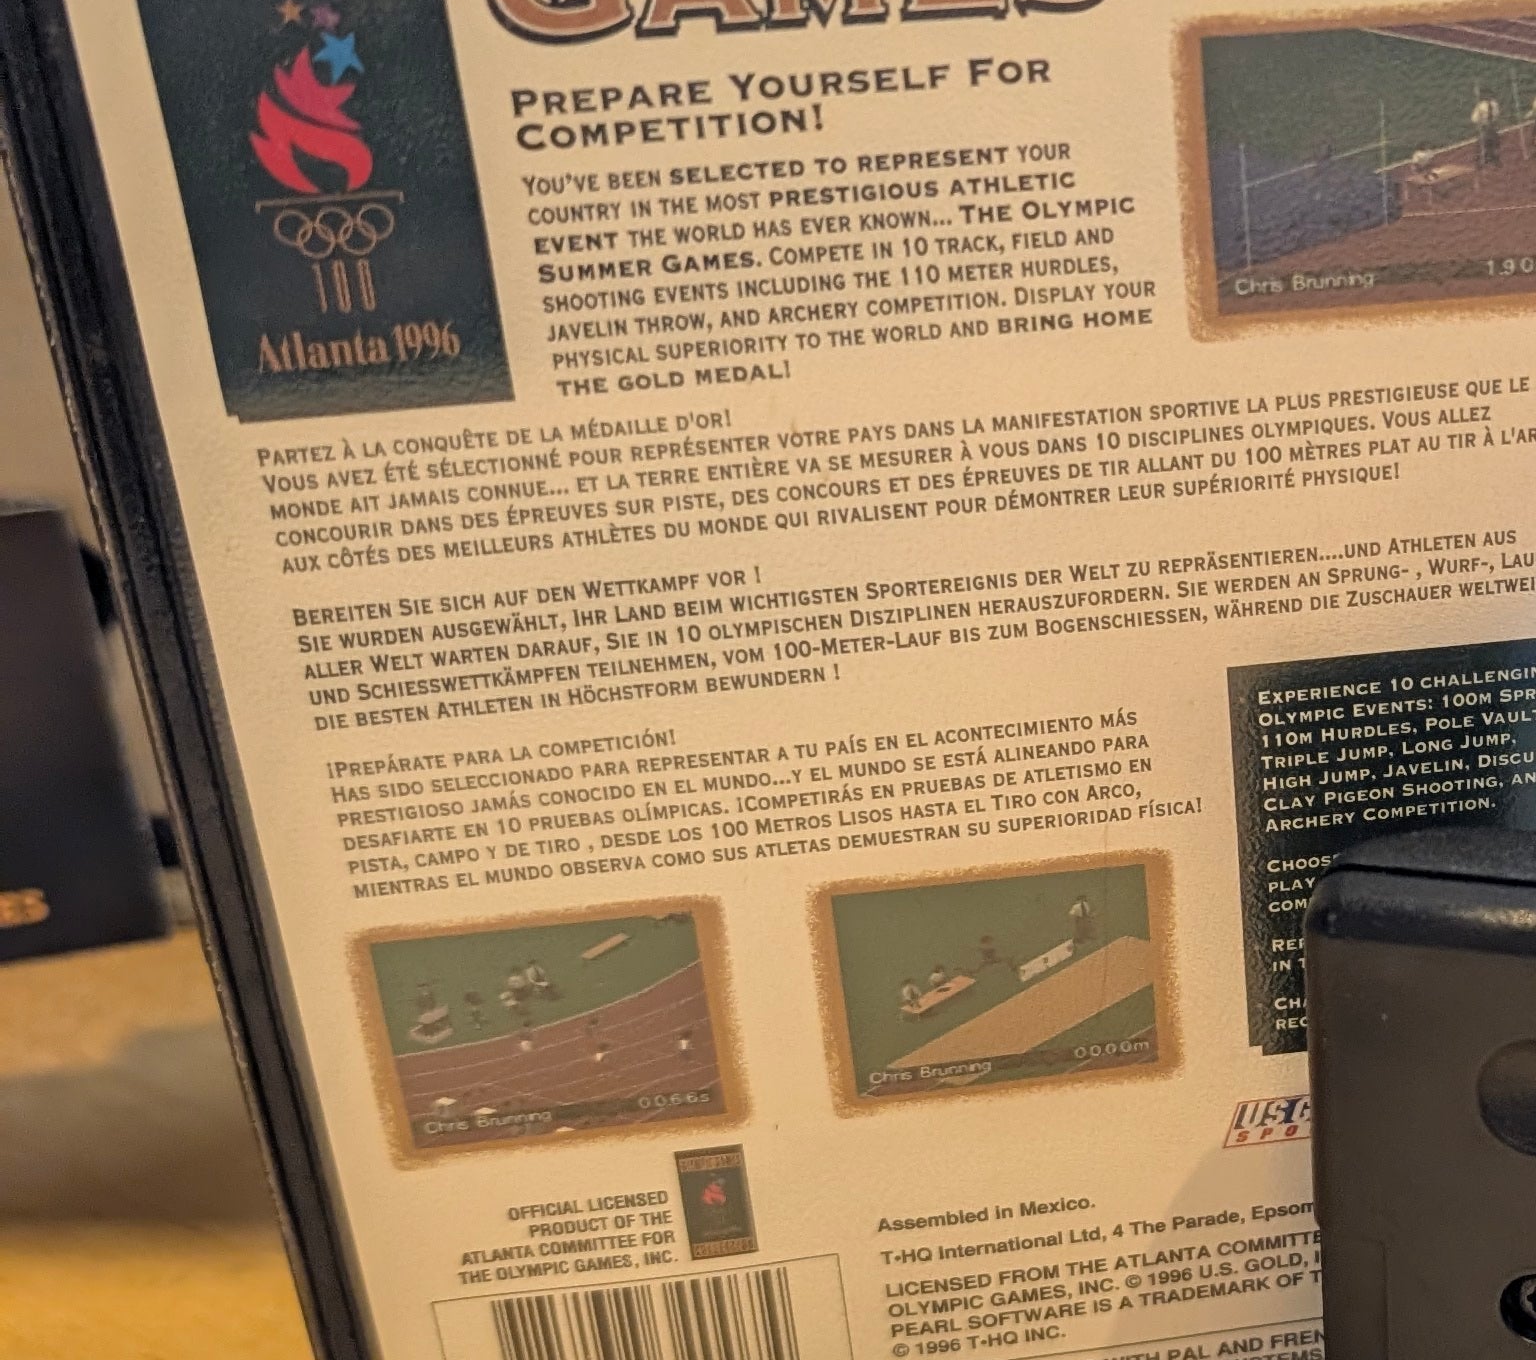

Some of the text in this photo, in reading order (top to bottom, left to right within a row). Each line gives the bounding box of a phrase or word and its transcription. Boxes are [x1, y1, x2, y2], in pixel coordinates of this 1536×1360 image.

[511, 58, 1050, 117] PREPARE YOURSELF FOR
[516, 106, 823, 151] COMPETITION!
[608, 170, 661, 190] BEEN
[669, 160, 805, 185] SELECTED
[813, 157, 847, 175] TO
[857, 146, 1009, 173] REPRESENT
[1017, 142, 1071, 163] YOUR
[527, 171, 1075, 226] COUNTRY IN THE MOST PRESTIGIOUS ATHLETIC
[533, 232, 618, 255] EVENT
[627, 228, 667, 248] THE
[674, 222, 746, 244] WORLD
[753, 219, 792, 238] HAS
[800, 215, 851, 235] EVER
[958, 204, 1013, 224] THE
[1021, 196, 1135, 220] OLYMPIC
[537, 227, 1114, 284] SUMMER GAMES. COMPETE IN 10 TRACK, FIELD AND
[1234, 277, 1283, 296] Chris
[258, 319, 463, 375] Atlanta 1996
[256, 445, 336, 468] PARTEZ
[362, 441, 387, 458] LA
[506, 428, 533, 446] DE
[539, 426, 563, 443] LA
[292, 602, 392, 627] BEREITEN
[398, 598, 434, 616] SIE
[440, 593, 486, 613] SICH
[494, 589, 529, 608] AUF
[536, 585, 576, 604] DEN
[582, 573, 699, 599] WETTKAMPF
[706, 570, 746, 588] VOR
[1258, 681, 1382, 705] EXPERIENCE
[1390, 676, 1414, 692] 10
[1258, 707, 1345, 727] OLYMPIC
[1425, 715, 1474, 731] POLE
[452, 749, 504, 767] PARA
[509, 746, 533, 762] LA
[1265, 797, 1496, 833] ARCHERY COMPETITION.
[1266, 854, 1339, 873] CHOOS
[868, 1068, 913, 1084] Chris
[507, 1190, 668, 1221] OFFICIAL LICENSED
[877, 1197, 1096, 1233] Assembled in Mexico.
[528, 1210, 672, 1238] PRODUCT OF THE
[938, 1231, 1063, 1260] International
[1112, 1223, 1124, 1238] 4
[1128, 1220, 1166, 1236] The
[1172, 1210, 1246, 1231] Parade,
[461, 1230, 675, 1266] ATLANTA COMMITTEE FOR
[457, 1268, 492, 1285] THE
[495, 1260, 570, 1281] OLYMPIC
[1217, 1337, 1264, 1357] AND
[1270, 1324, 1324, 1349] FREN
